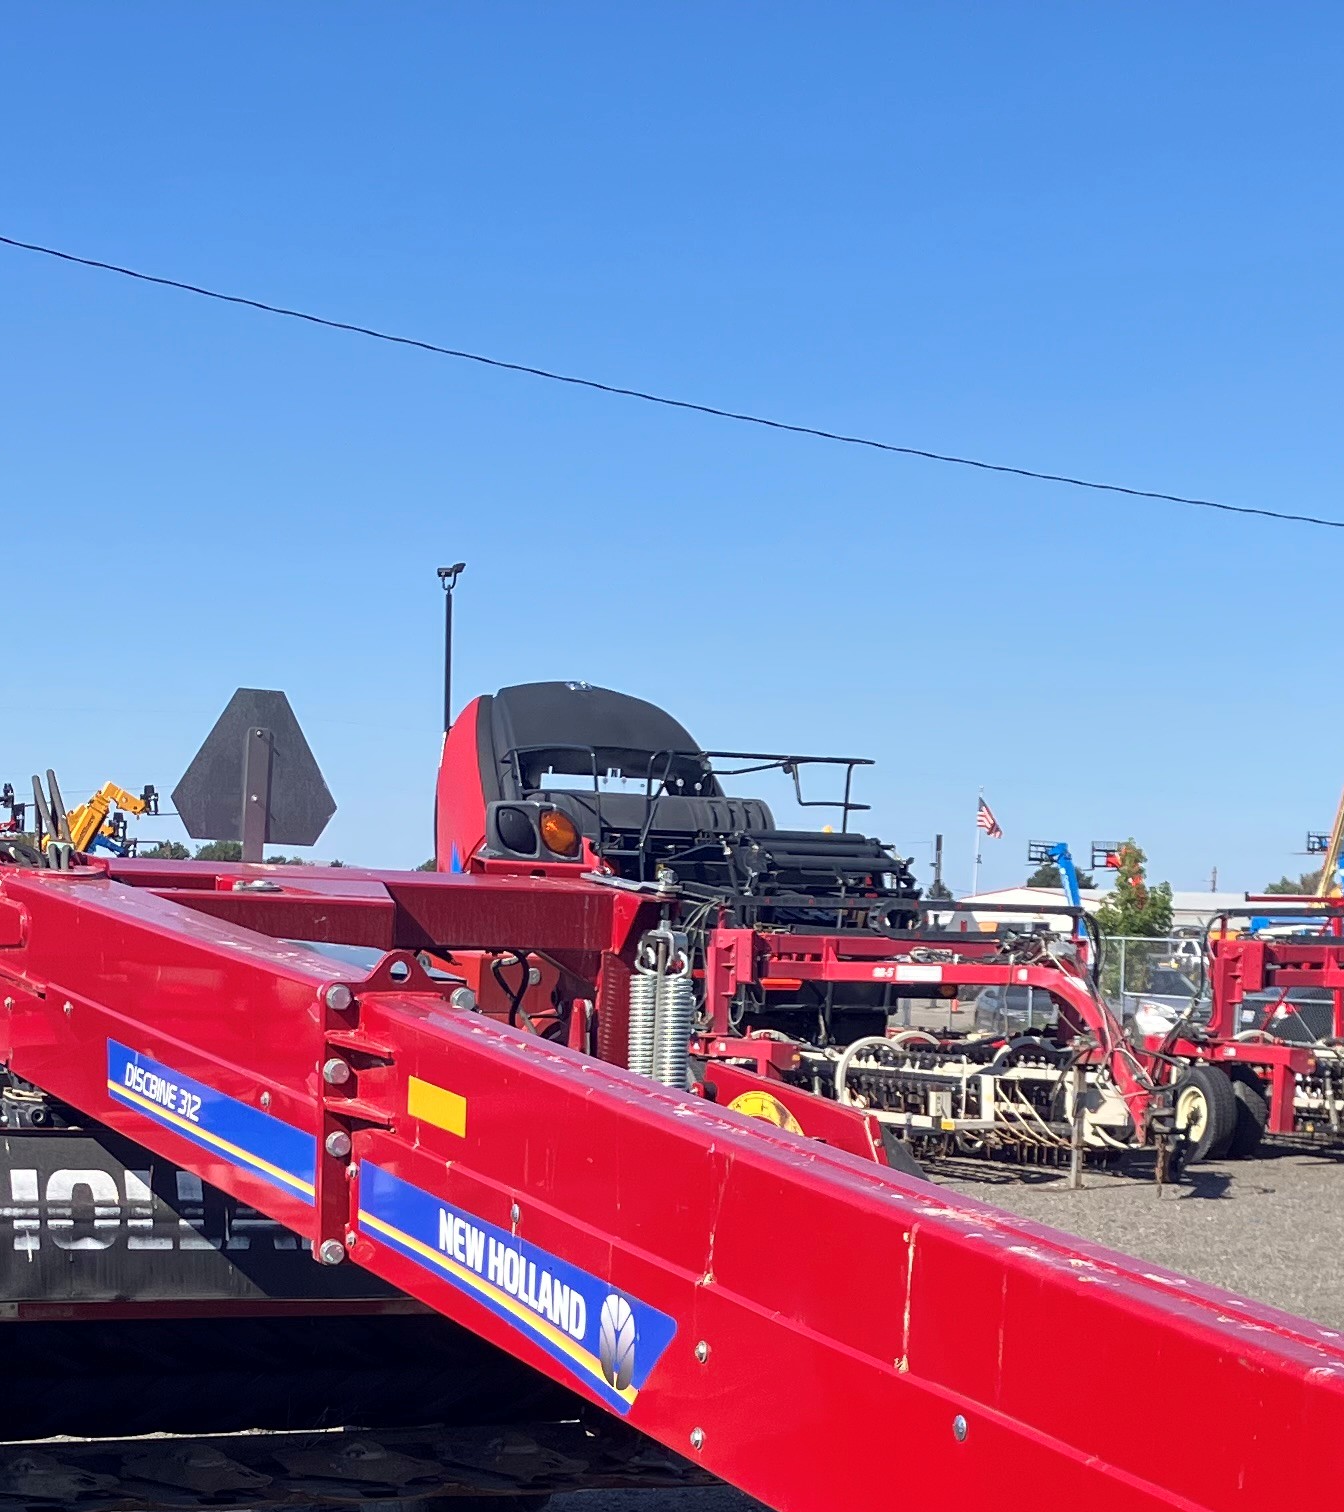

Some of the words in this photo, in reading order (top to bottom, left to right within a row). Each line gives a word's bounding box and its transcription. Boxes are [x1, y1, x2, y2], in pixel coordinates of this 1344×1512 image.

[124, 1062, 177, 1110] DISCBINE
[177, 1088, 202, 1123] 312
[439, 1207, 486, 1274] NEW
[488, 1236, 587, 1341] HOLLAND
